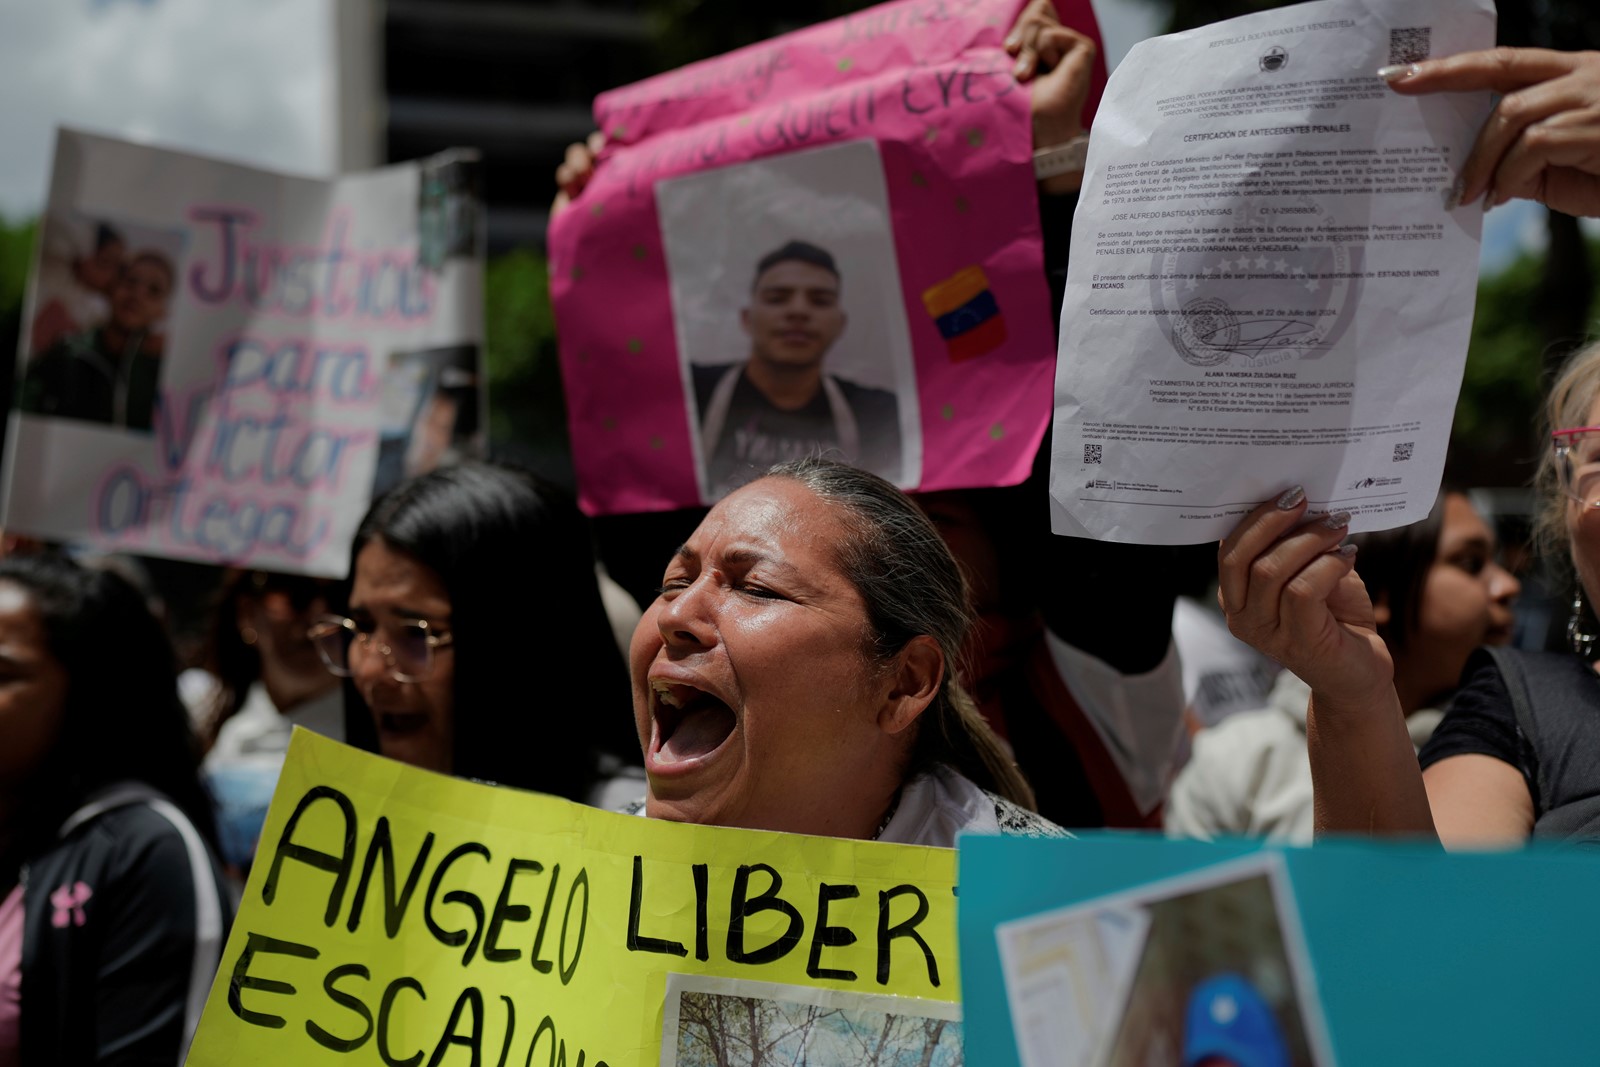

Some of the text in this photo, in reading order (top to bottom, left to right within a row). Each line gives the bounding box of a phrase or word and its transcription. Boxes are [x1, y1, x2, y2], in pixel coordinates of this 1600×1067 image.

[1183, 125, 1351, 143] CERTIFICACIÓN DE ANTECEDENTES PENALES
[1117, 161, 1138, 170] nombre
[1139, 160, 1150, 168] del
[1150, 157, 1184, 167] Ciudadano
[1185, 155, 1211, 163] Ministro
[1212, 153, 1223, 161] del
[1224, 152, 1245, 160] Poder
[1111, 213, 1128, 221] JOSE
[1129, 211, 1161, 220] ALFREDO
[1161, 209, 1196, 218] BASTIDAS
[1195, 208, 1233, 216] VENEGAS
[1107, 230, 1134, 239] constata,
[1136, 229, 1153, 238] luego
[1164, 227, 1192, 235] revisada
[1276, 225, 1303, 233] Oficina
[1316, 224, 1369, 232] Antecedentes
[1095, 247, 1125, 255] PENALES
[1186, 244, 1237, 253] BOLIVARIANA
[189, 206, 435, 323] Justicia
[1100, 273, 1126, 282] presente
[1247, 273, 1288, 281] presentado
[1320, 271, 1364, 279] autoridades
[222, 336, 378, 412] para
[1207, 380, 1238, 388] POLÍTICA
[98, 467, 328, 557] Ortega
[263, 786, 957, 987] ANGELO LIBER
